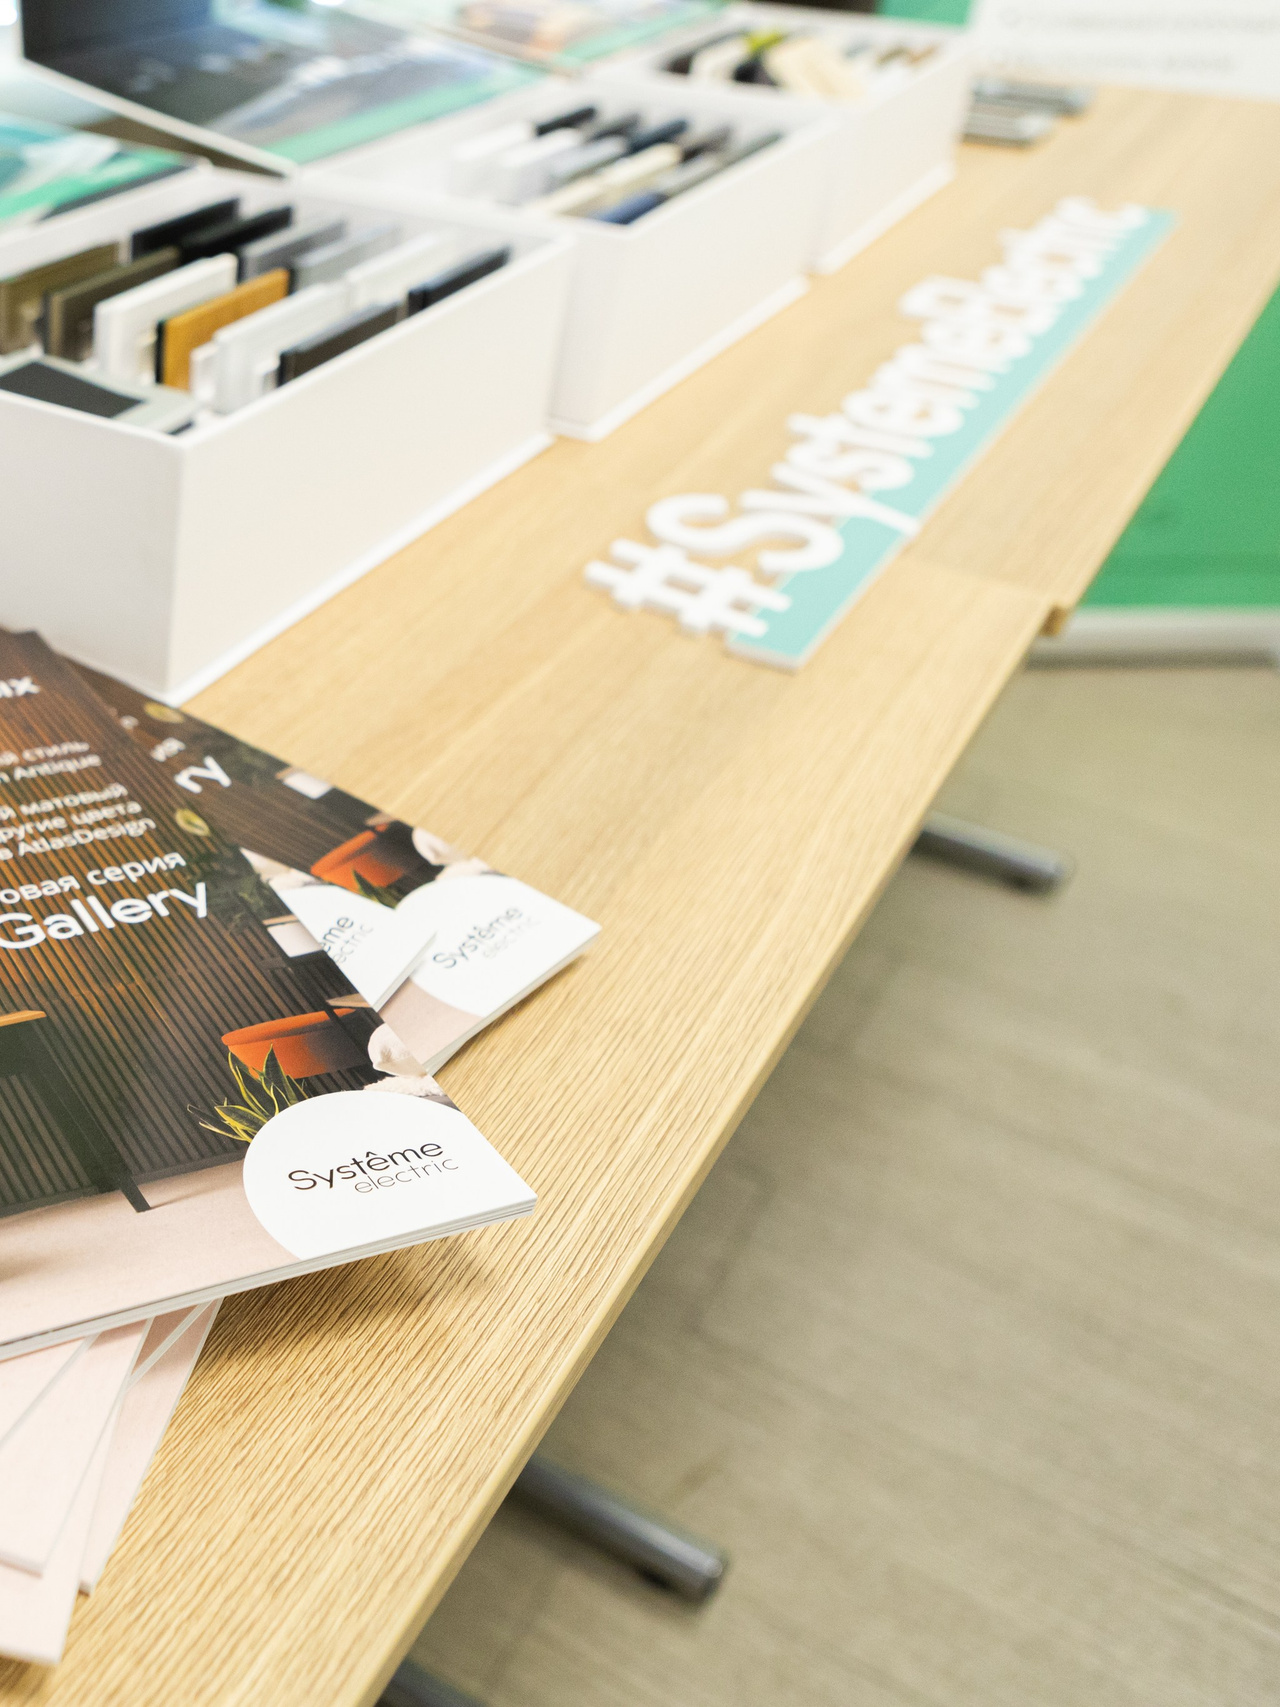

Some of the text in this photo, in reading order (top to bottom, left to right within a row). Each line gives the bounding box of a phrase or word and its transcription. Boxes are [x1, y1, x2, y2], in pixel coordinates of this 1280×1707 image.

[13, 754, 101, 781] Antique
[22, 741, 90, 762] стиль
[19, 782, 128, 816] матовый
[71, 800, 142, 825] цвета
[18, 816, 156, 857] AtlasDesign
[87, 851, 187, 883] серия
[288, 1143, 444, 1190] Systême
[355, 1156, 459, 1194] electric
